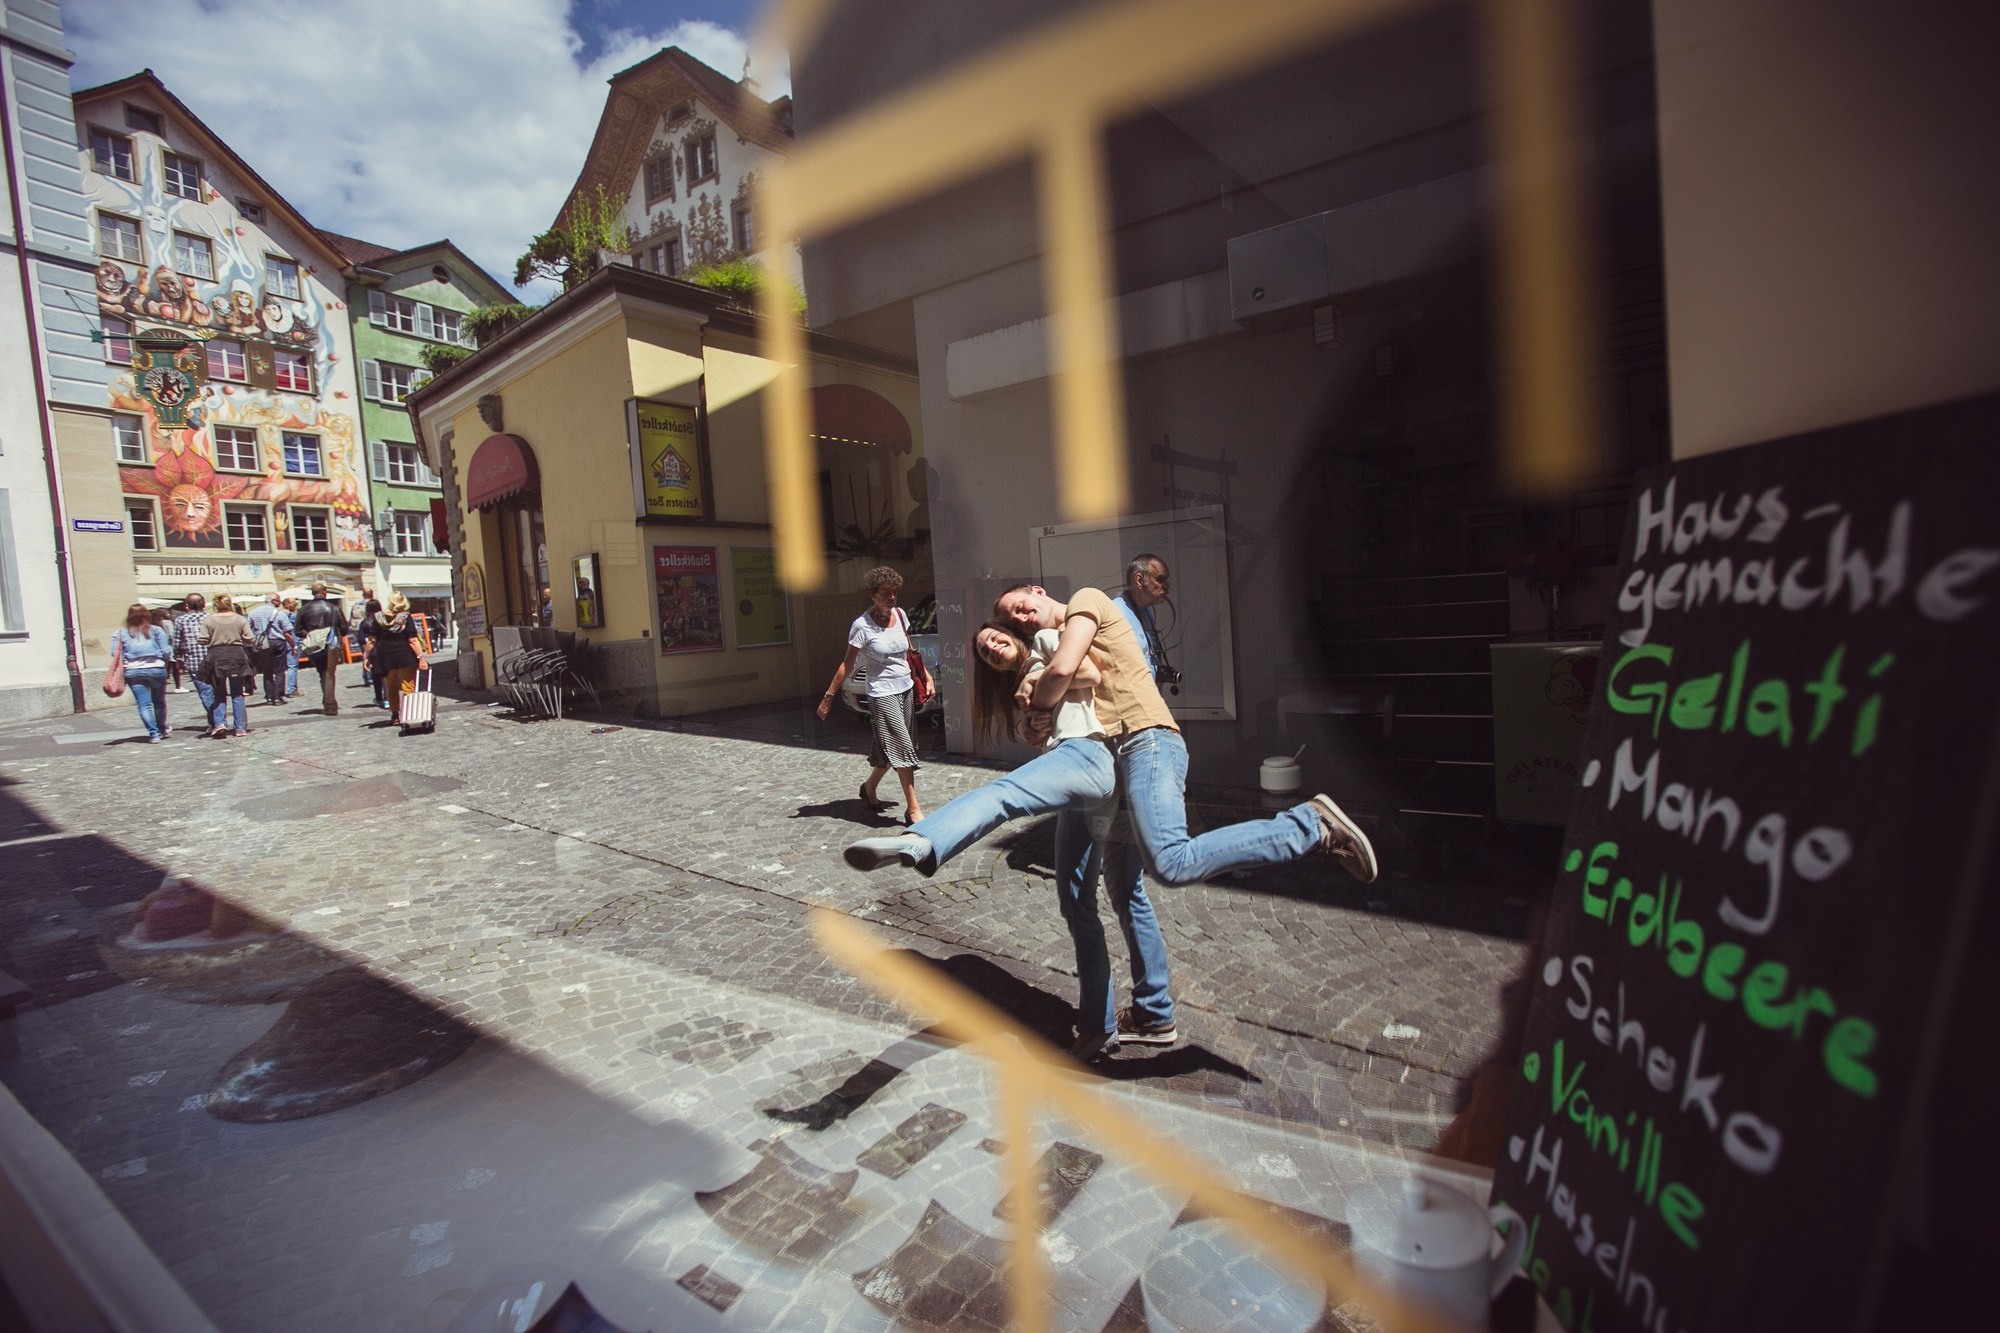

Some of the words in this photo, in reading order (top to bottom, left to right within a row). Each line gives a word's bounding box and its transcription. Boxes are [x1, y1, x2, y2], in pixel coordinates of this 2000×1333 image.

[1617, 499, 2000, 647] gemachte
[1508, 757, 1578, 783] GELATERI
[1606, 639, 1896, 757] Gelati
[1608, 737, 1852, 935] Mango
[1567, 954, 1784, 1174] Schoko
[1582, 841, 1880, 1098] Erdbeere
[1552, 1040, 1706, 1251] Vanille
